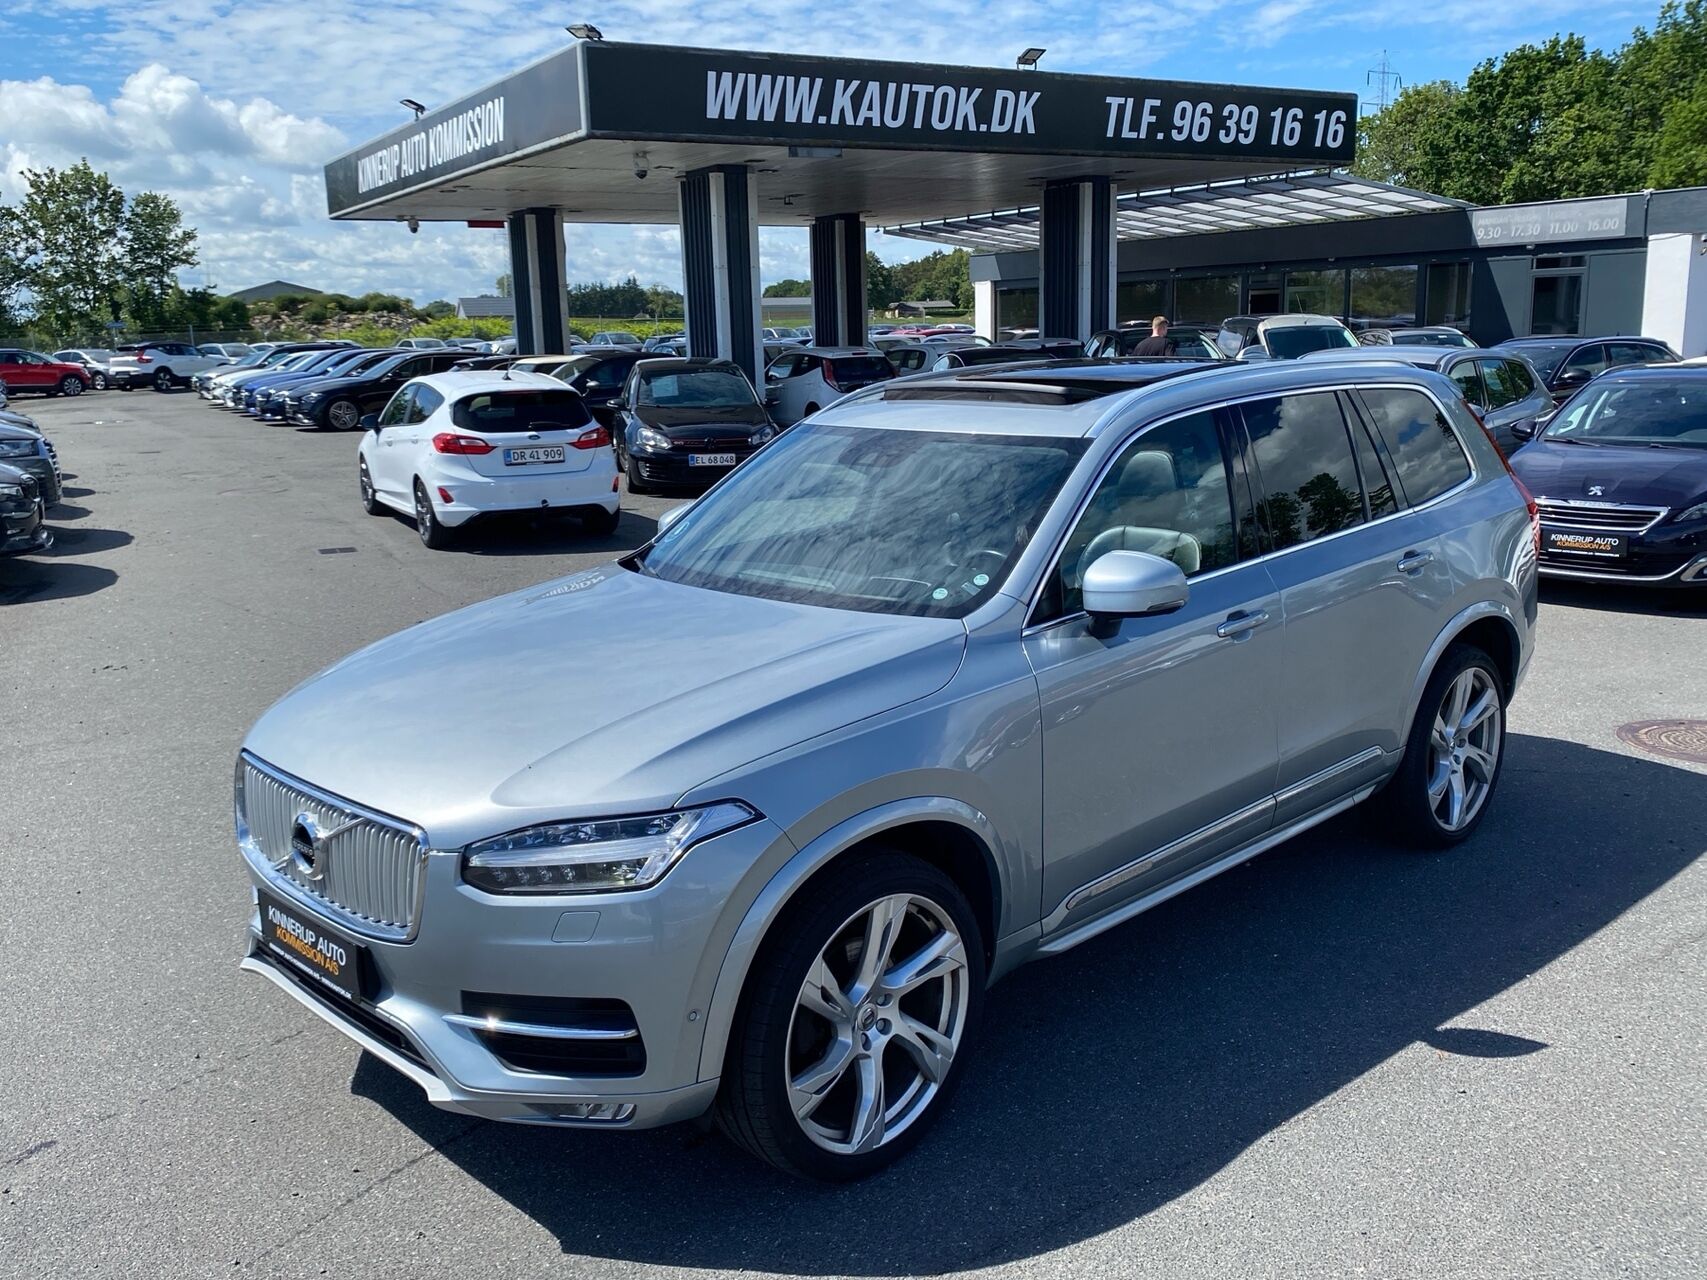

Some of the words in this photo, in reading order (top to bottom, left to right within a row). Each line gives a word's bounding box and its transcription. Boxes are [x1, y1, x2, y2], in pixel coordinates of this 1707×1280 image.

[706, 71, 1041, 134] WWW.KAUTOK.DK
[1105, 96, 1164, 140] TLF.
[1171, 101, 1213, 142] 96
[1219, 104, 1259, 144] 39
[1270, 107, 1304, 146] 16
[1314, 110, 1347, 148] 16
[358, 144, 400, 194] KINNERUP
[401, 132, 427, 178] AUTO
[429, 96, 505, 168] KOMMISSION
[1477, 227, 1502, 240] 9.30
[1511, 223, 1541, 238] 17.30
[1550, 221, 1579, 234] 11.00
[1588, 218, 1619, 232] 16.00
[512, 451, 527, 461] DR
[529, 450, 540, 460] 41
[543, 449, 562, 459] 909
[696, 456, 706, 464] EL
[708, 455, 719, 464] 68
[720, 455, 735, 464] 048
[1551, 534, 1593, 543] KINNERUP
[1595, 537, 1619, 546] AUTO
[268, 905, 316, 945] KINNERUP
[317, 937, 347, 967] AUTO
[276, 926, 325, 966] KOMMISSION
[325, 960, 339, 976] A/S
